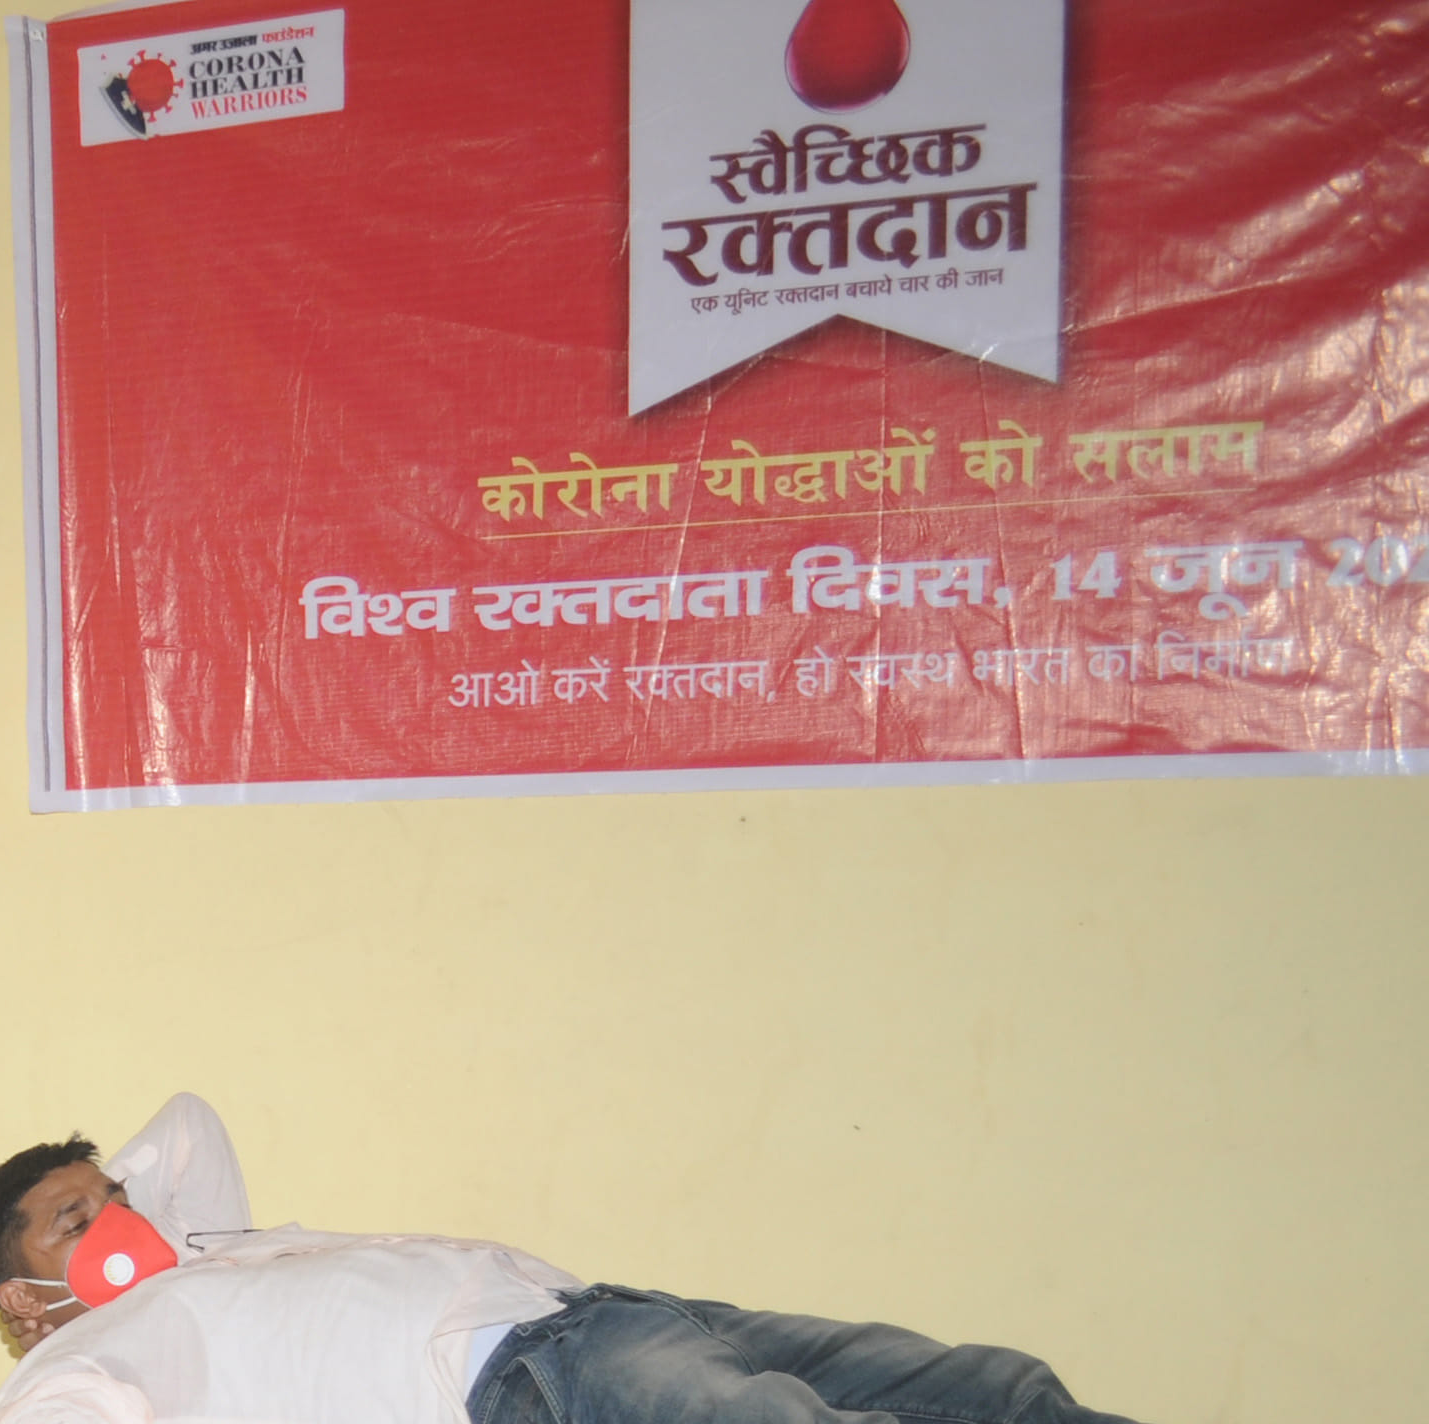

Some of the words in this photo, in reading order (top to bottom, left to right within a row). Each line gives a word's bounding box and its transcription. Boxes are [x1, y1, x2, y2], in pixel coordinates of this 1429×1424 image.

[189, 46, 305, 80] CORONA
[190, 66, 304, 99] HEALTH
[191, 87, 307, 119] WARRIORS
[710, 123, 987, 203] स्वैच्छिक
[661, 182, 1038, 287] रक्तदान
[691, 296, 719, 314] एक
[725, 288, 770, 315] यूनिट
[775, 283, 840, 304] रक्तदान
[845, 274, 893, 298] बचाये
[898, 275, 930, 293] चार
[935, 268, 959, 290] की
[965, 268, 1004, 287] जान
[477, 452, 678, 522] कोरोना
[700, 427, 936, 506] योद्धाओं
[960, 420, 1043, 493] को
[1069, 421, 1265, 484] सलाम
[298, 576, 456, 639] विश्व
[473, 569, 769, 631] रक्तदाता
[787, 545, 1013, 614] दिवस,
[1050, 551, 1123, 600] 14
[1144, 540, 1304, 620] जून
[448, 658, 541, 708] आओ
[551, 655, 611, 702] करें
[623, 660, 776, 702] रक्तदान,
[794, 645, 833, 695] हो
[846, 650, 955, 692] स्वस्थ
[972, 647, 1071, 690] भारत
[1086, 644, 1139, 683] का
[1154, 629, 1295, 681] निर्माण
